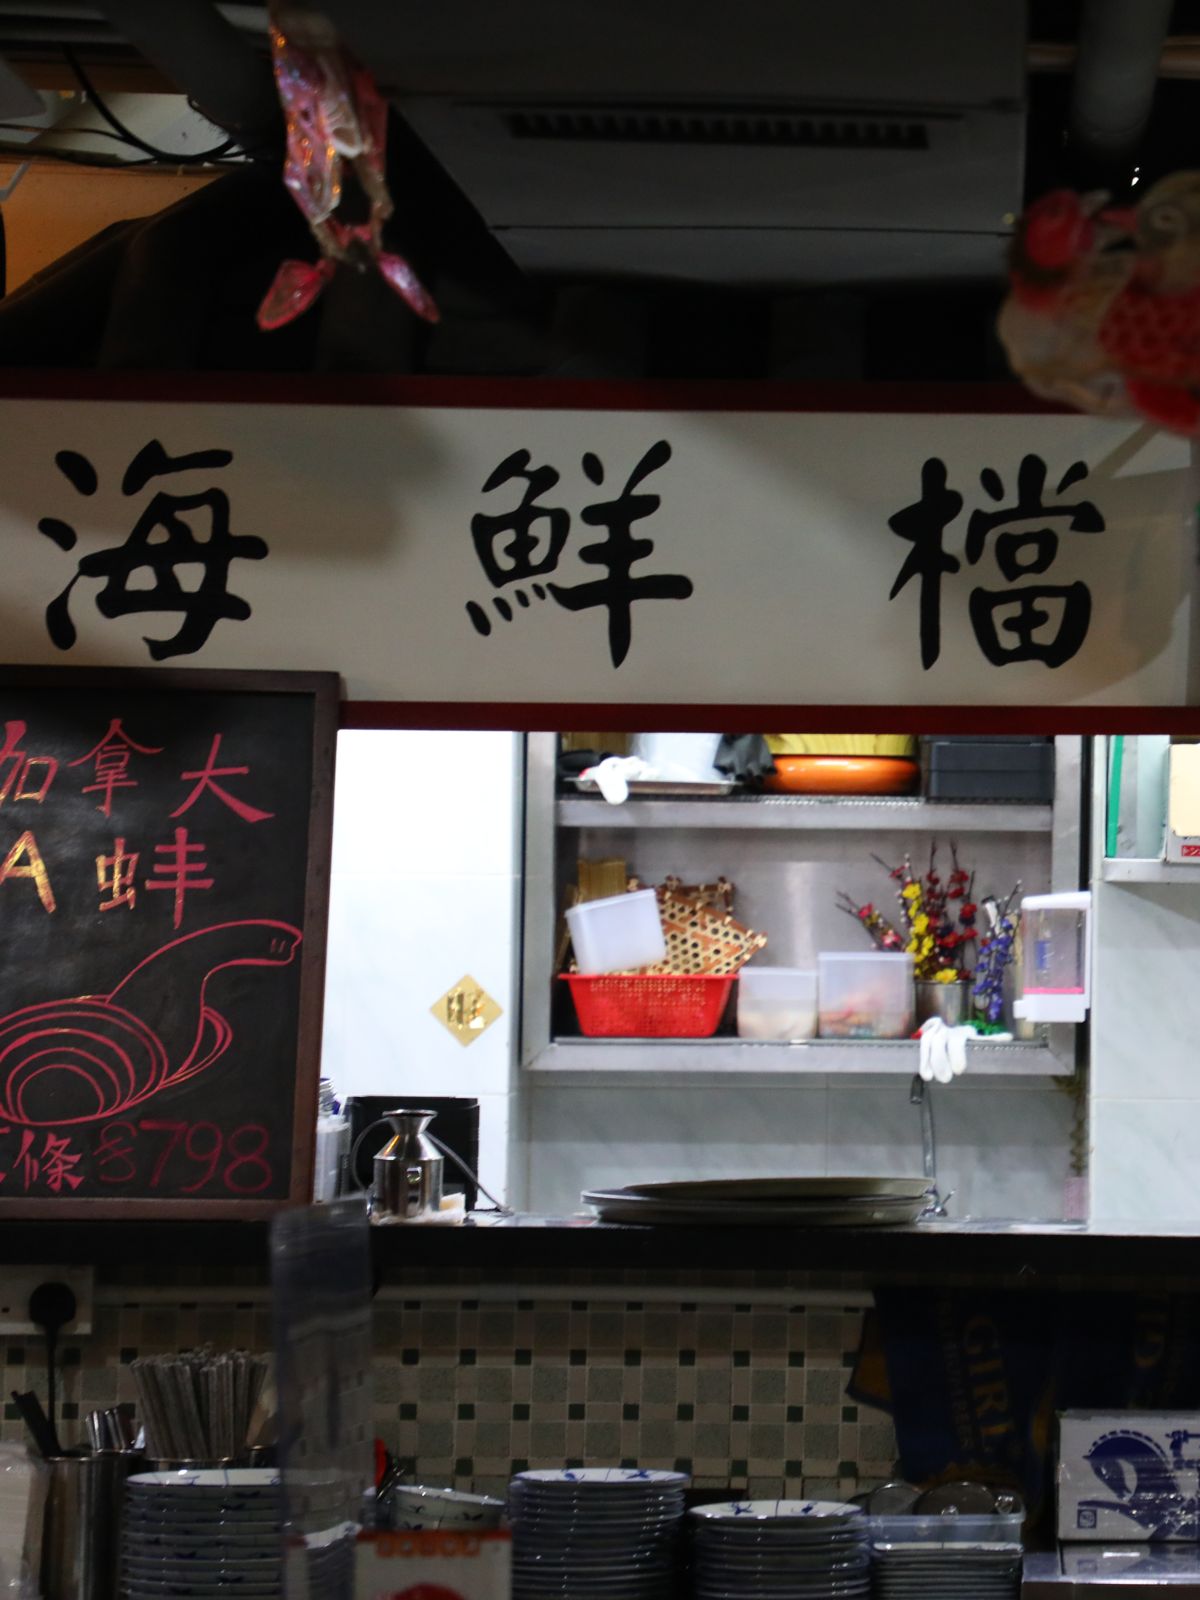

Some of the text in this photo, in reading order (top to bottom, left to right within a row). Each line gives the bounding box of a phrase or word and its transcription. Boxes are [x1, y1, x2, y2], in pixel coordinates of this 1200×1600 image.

[37, 438, 1106, 671] 海鮮檔
[0, 718, 275, 822] 加拿大
[0, 1126, 85, 1193] 條
